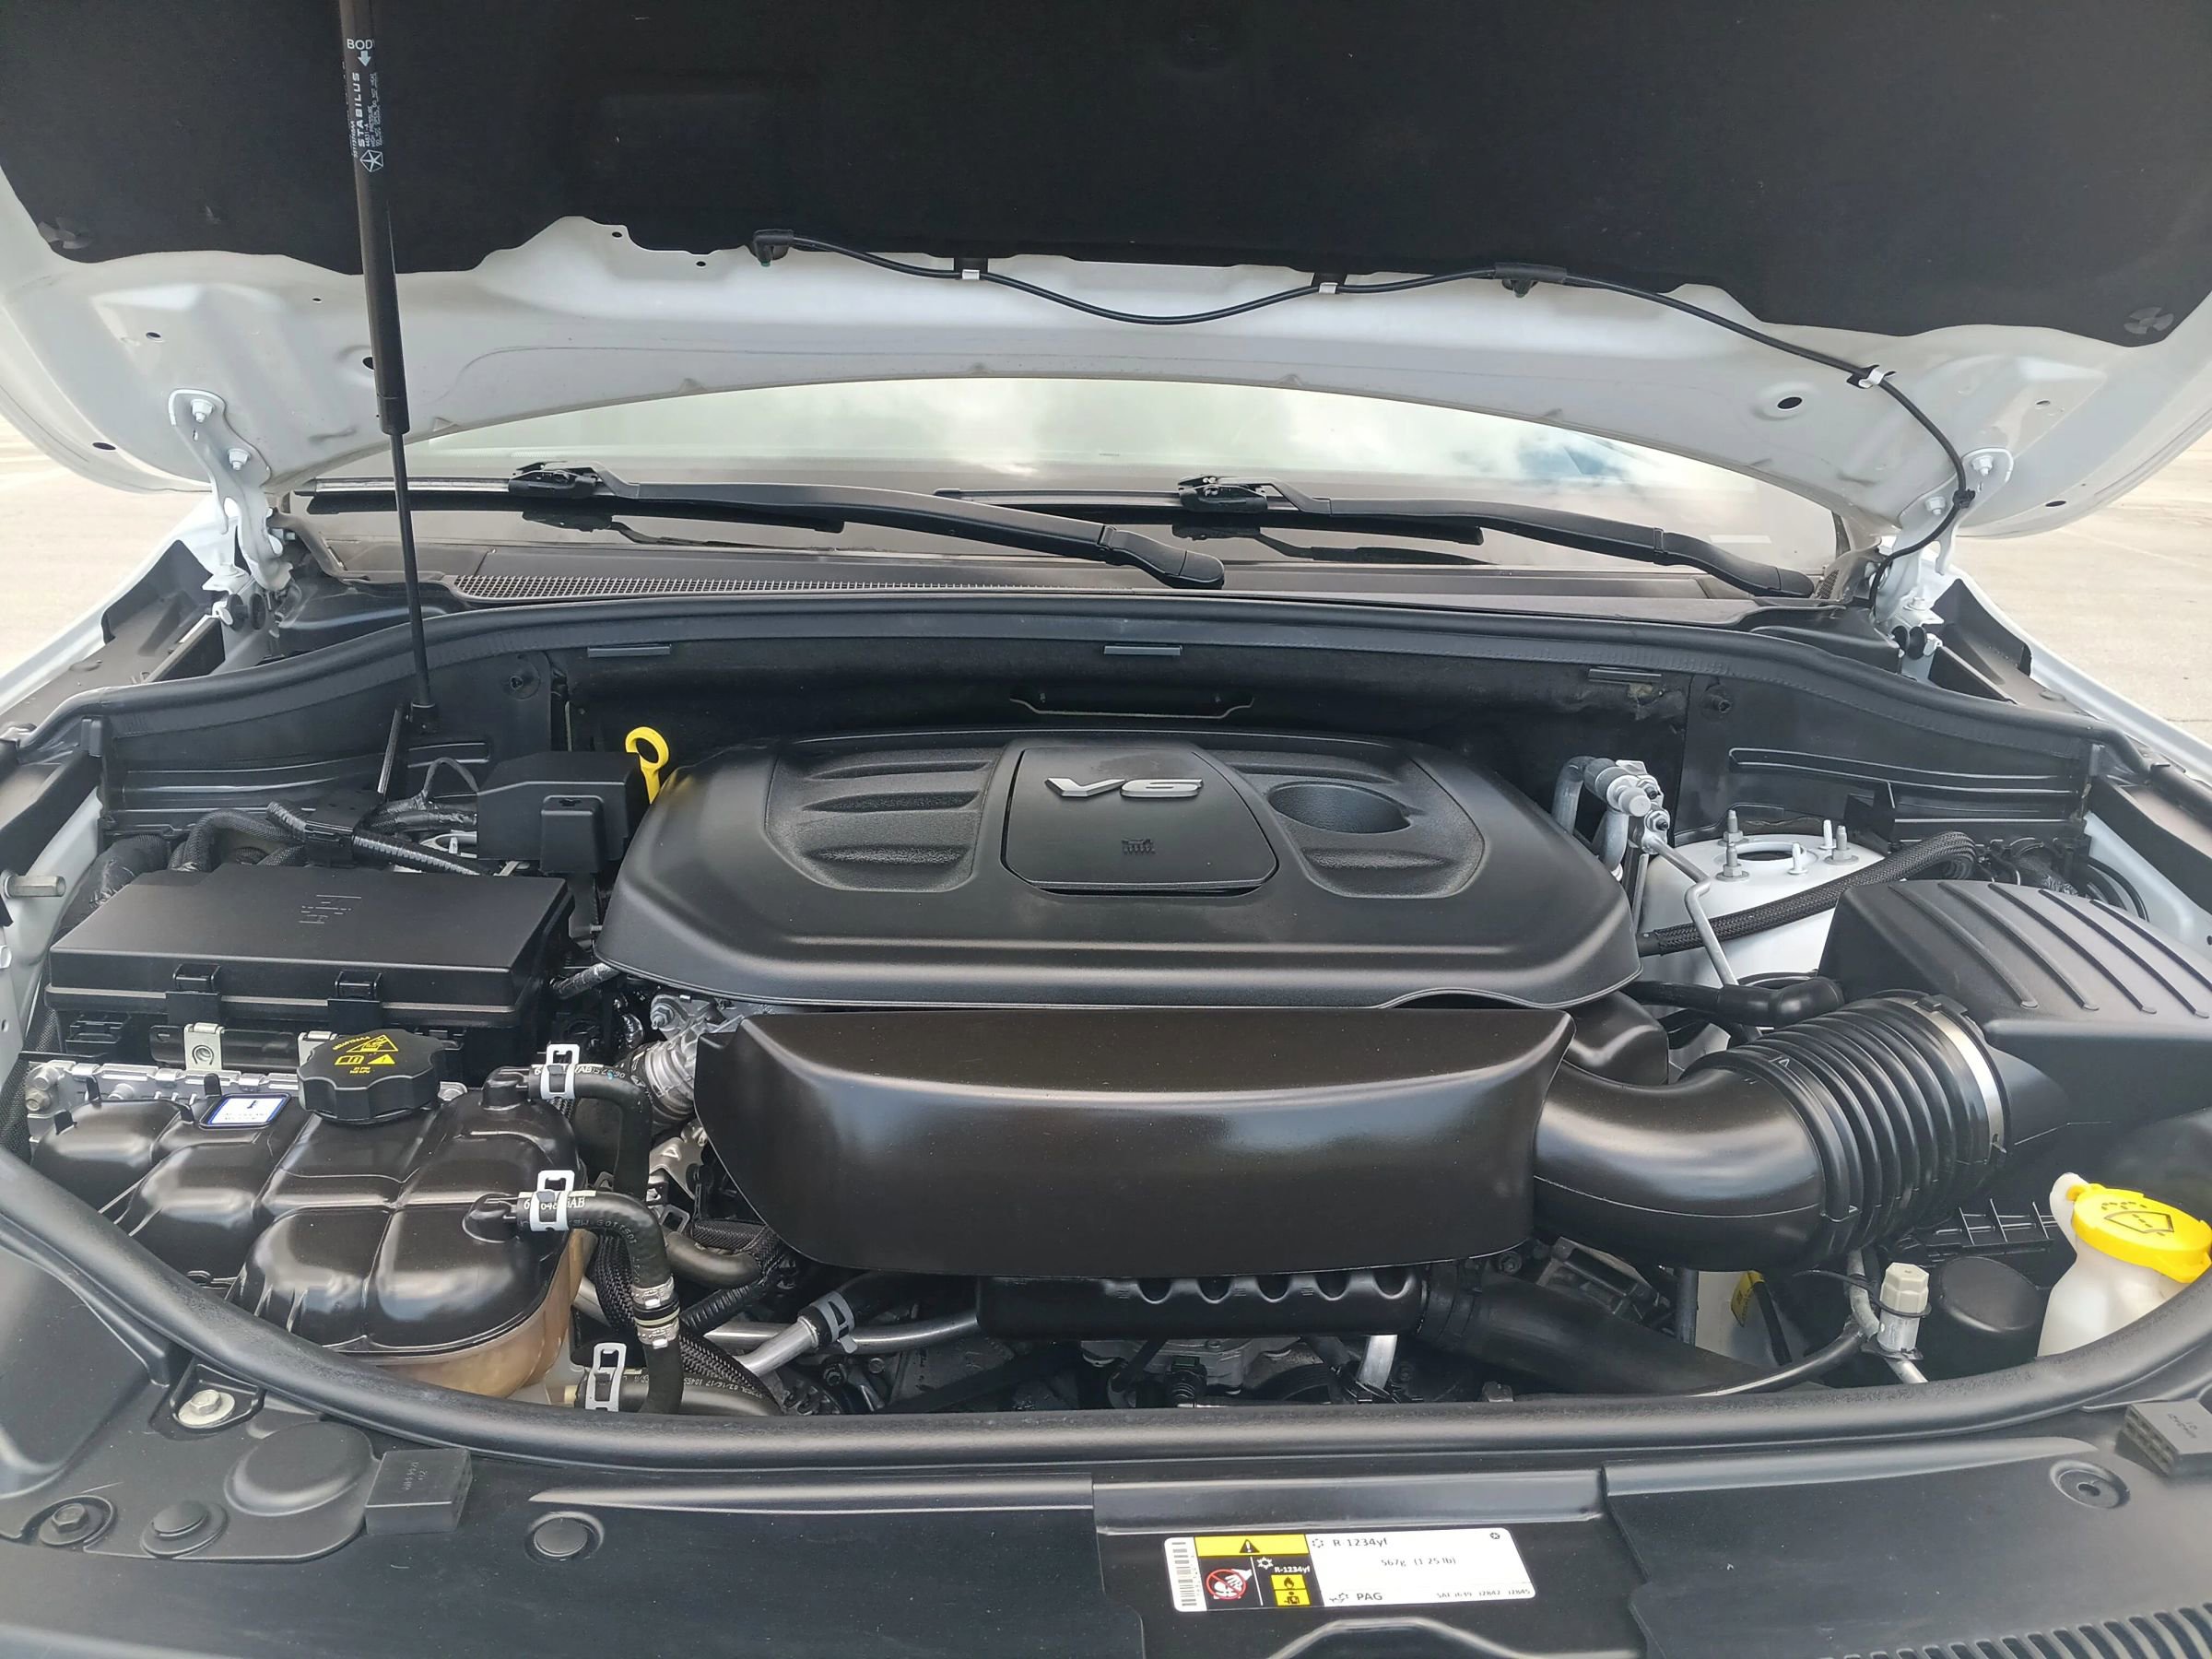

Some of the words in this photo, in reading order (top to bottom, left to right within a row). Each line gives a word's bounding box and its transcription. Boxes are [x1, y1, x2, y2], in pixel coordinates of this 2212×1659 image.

[352, 72, 365, 147] STABILUS
[1044, 777, 1205, 798] V6
[1274, 1565, 1311, 1573] R-1234yf
[1356, 1593, 1383, 1602] PAG
